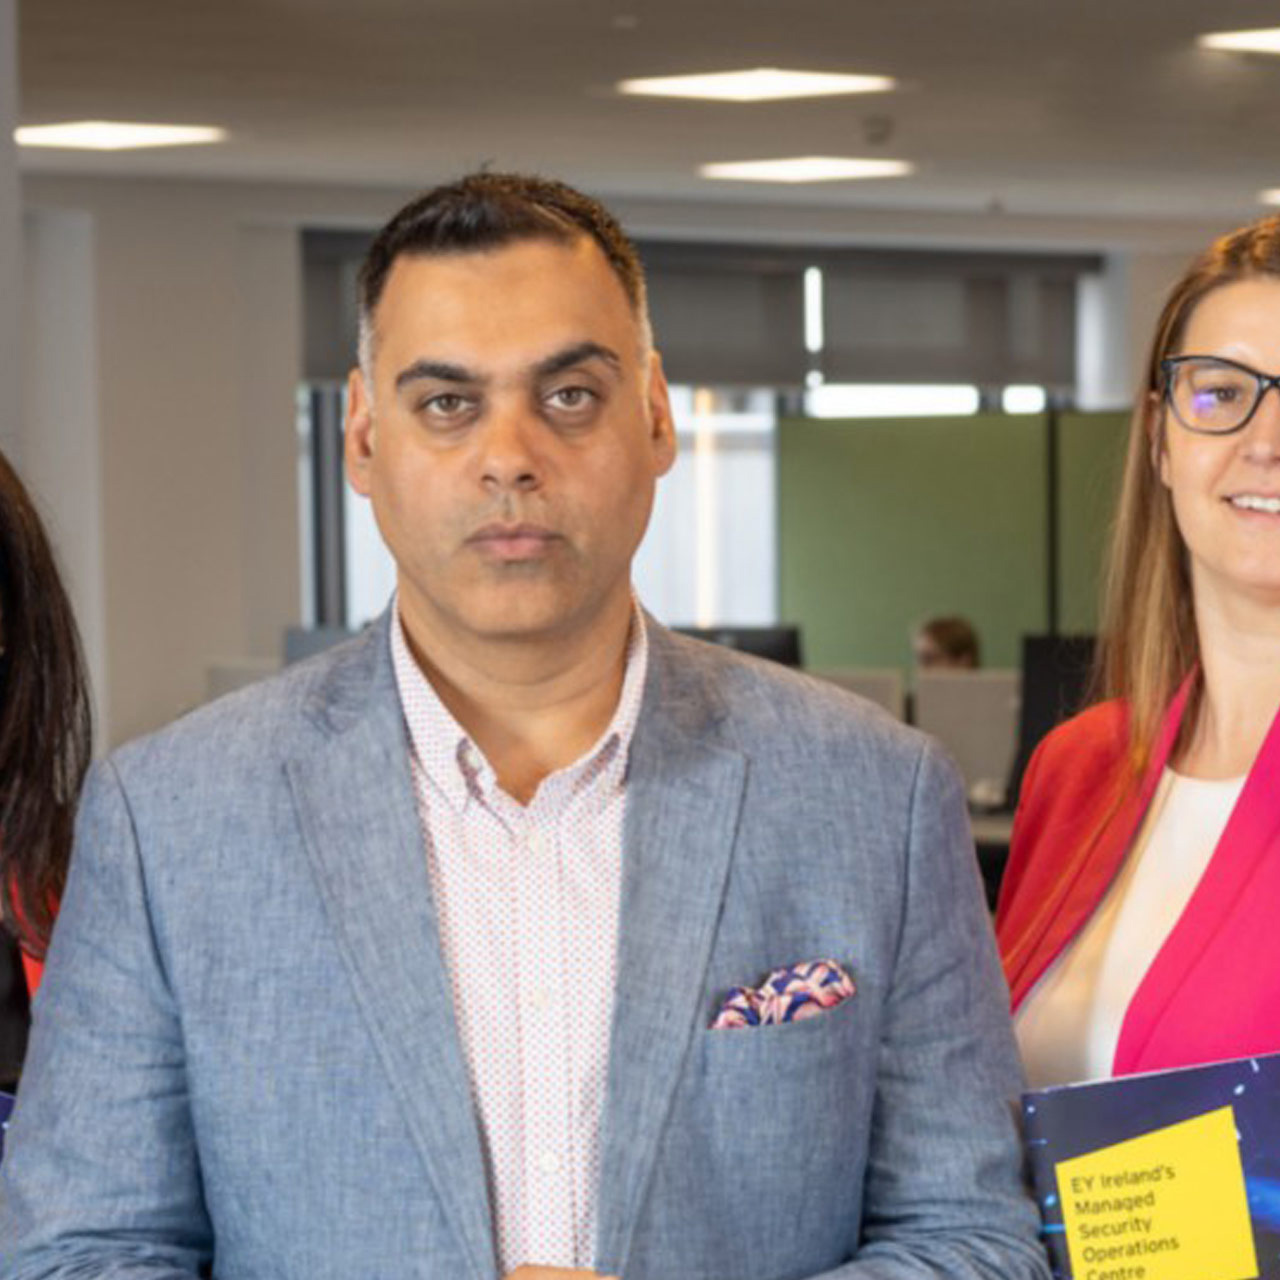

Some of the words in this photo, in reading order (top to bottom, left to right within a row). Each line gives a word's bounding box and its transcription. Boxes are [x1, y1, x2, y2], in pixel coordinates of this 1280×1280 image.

[1071, 1176, 1094, 1193] EY
[1100, 1165, 1176, 1189] Ireland's
[1075, 1190, 1156, 1214] Managed
[1078, 1217, 1152, 1240] Security
[1082, 1237, 1180, 1263] Operations
